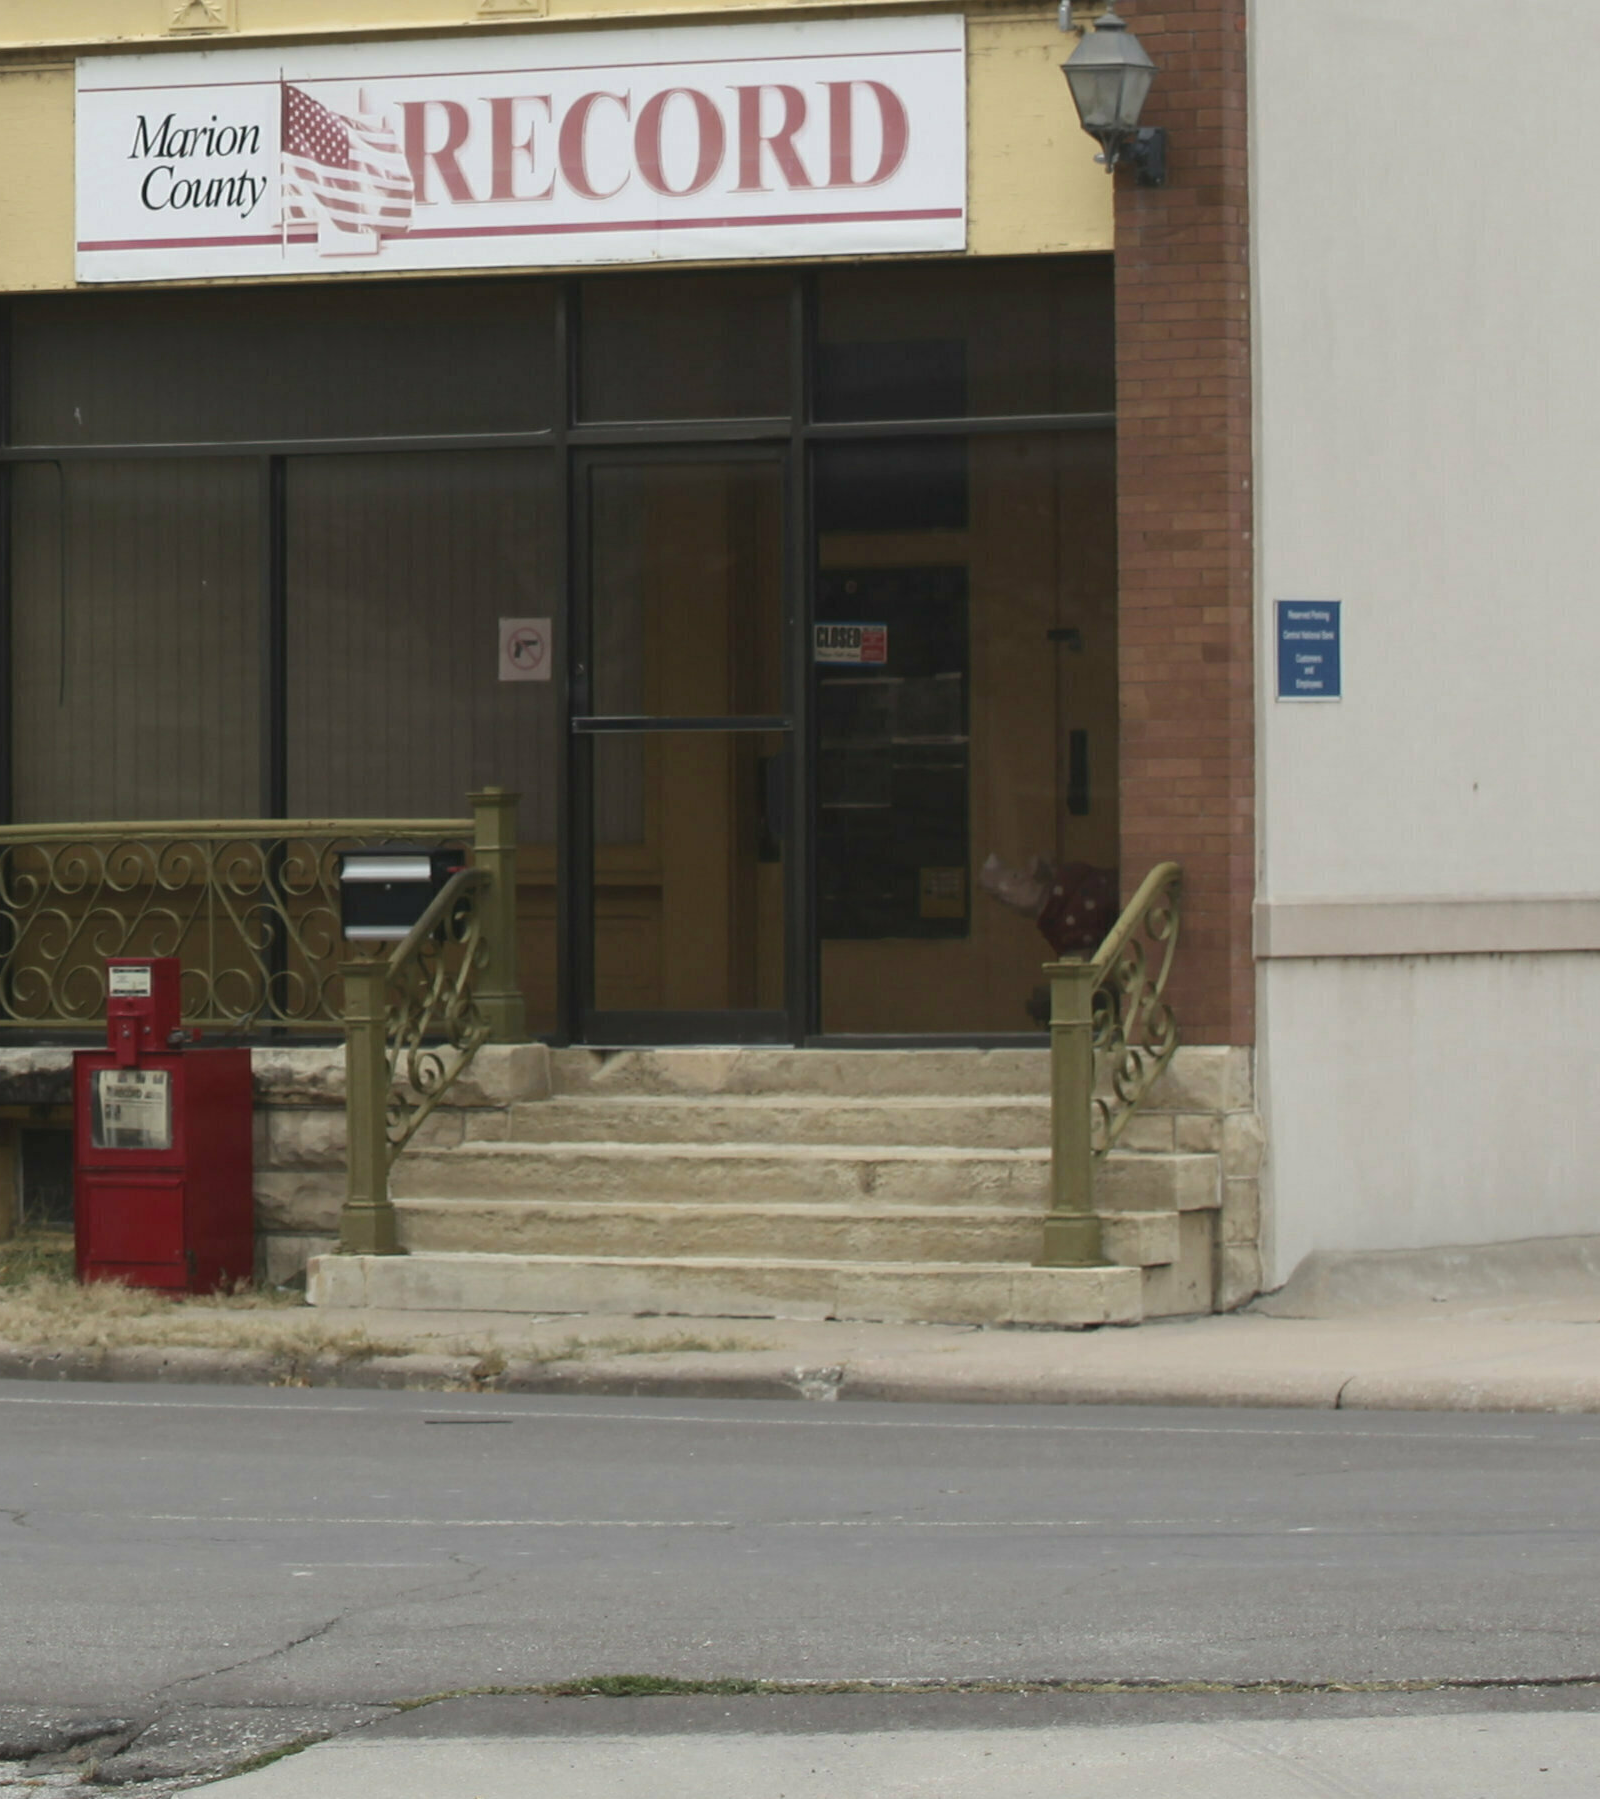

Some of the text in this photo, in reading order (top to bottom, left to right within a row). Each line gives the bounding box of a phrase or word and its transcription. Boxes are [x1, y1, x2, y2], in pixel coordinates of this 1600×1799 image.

[127, 112, 261, 160] Marion
[393, 78, 911, 206] RECORD
[140, 164, 268, 220] County
[816, 626, 861, 649] CLOSED
